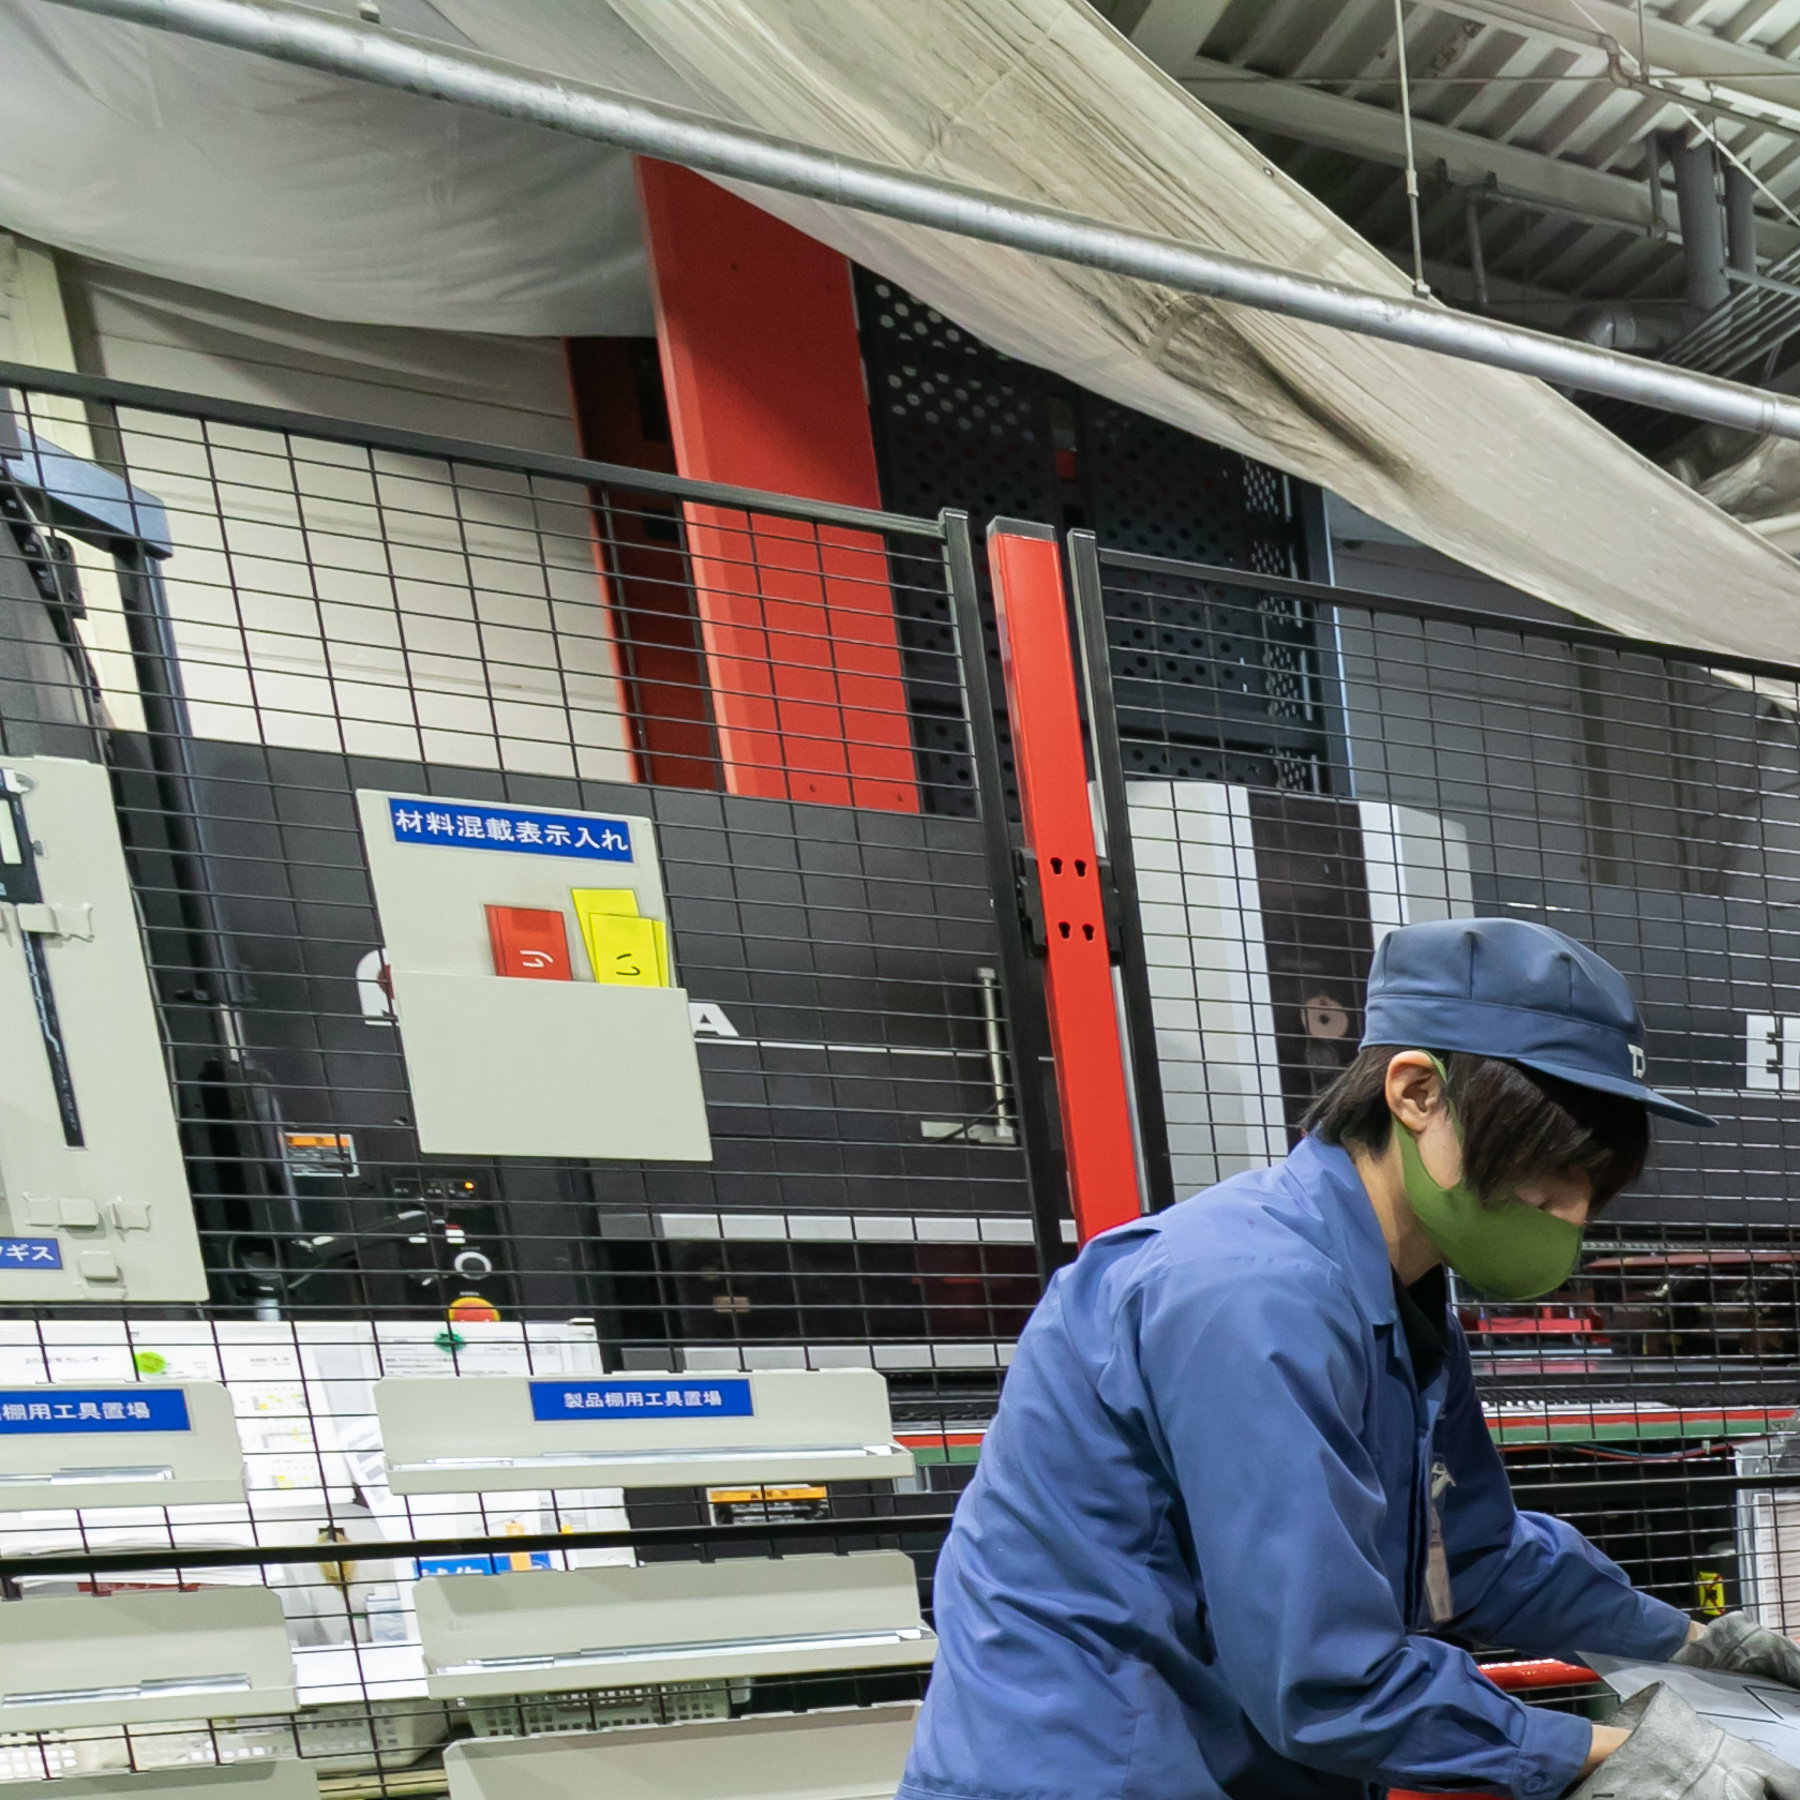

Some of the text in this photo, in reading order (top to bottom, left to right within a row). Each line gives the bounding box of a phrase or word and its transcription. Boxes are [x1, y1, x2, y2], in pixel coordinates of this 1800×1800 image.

[395, 809, 629, 851] 材料混載表示入れ
[0, 1243, 55, 1262] ギス
[563, 1390, 722, 1409] 製品棚用工具置場
[0, 1401, 151, 1421] 棚用工具置場
